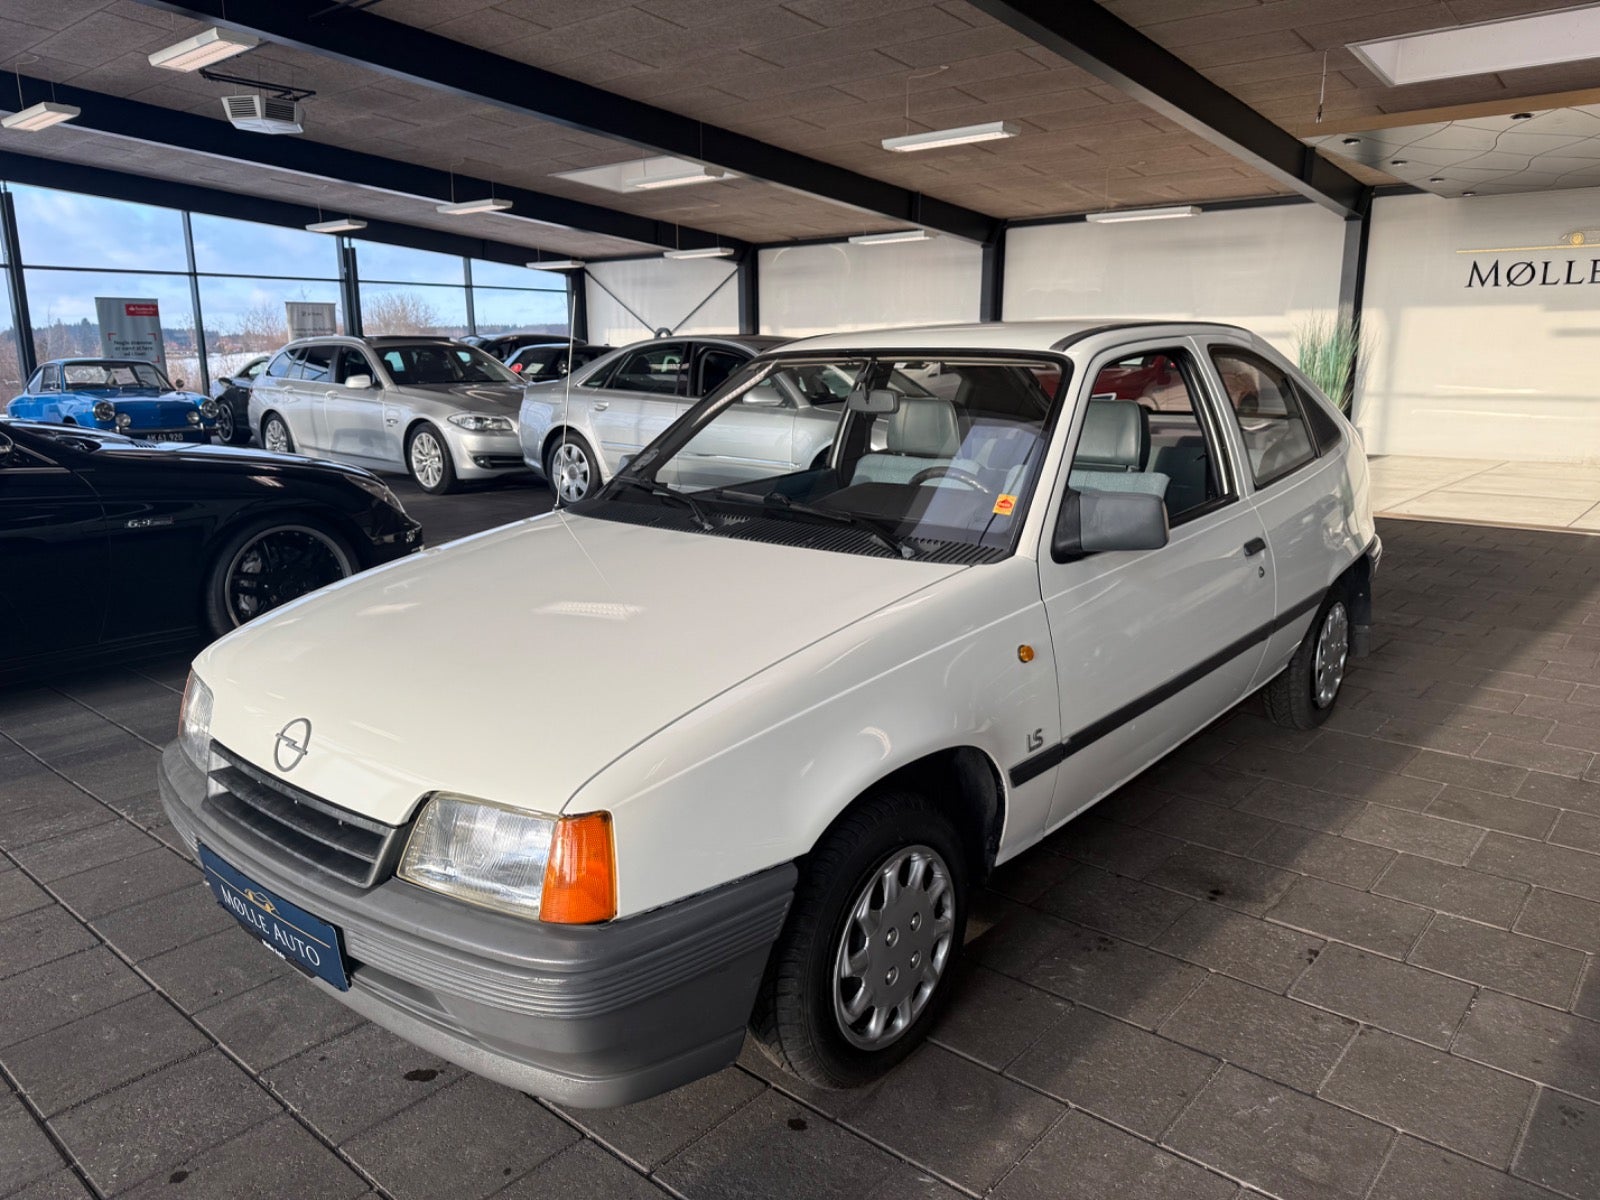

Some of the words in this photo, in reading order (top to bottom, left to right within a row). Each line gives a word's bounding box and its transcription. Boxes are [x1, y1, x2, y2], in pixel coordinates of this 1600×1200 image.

[1027, 728, 1044, 753] LS
[220, 884, 270, 934] MØLLE
[273, 922, 321, 967] AUTO
